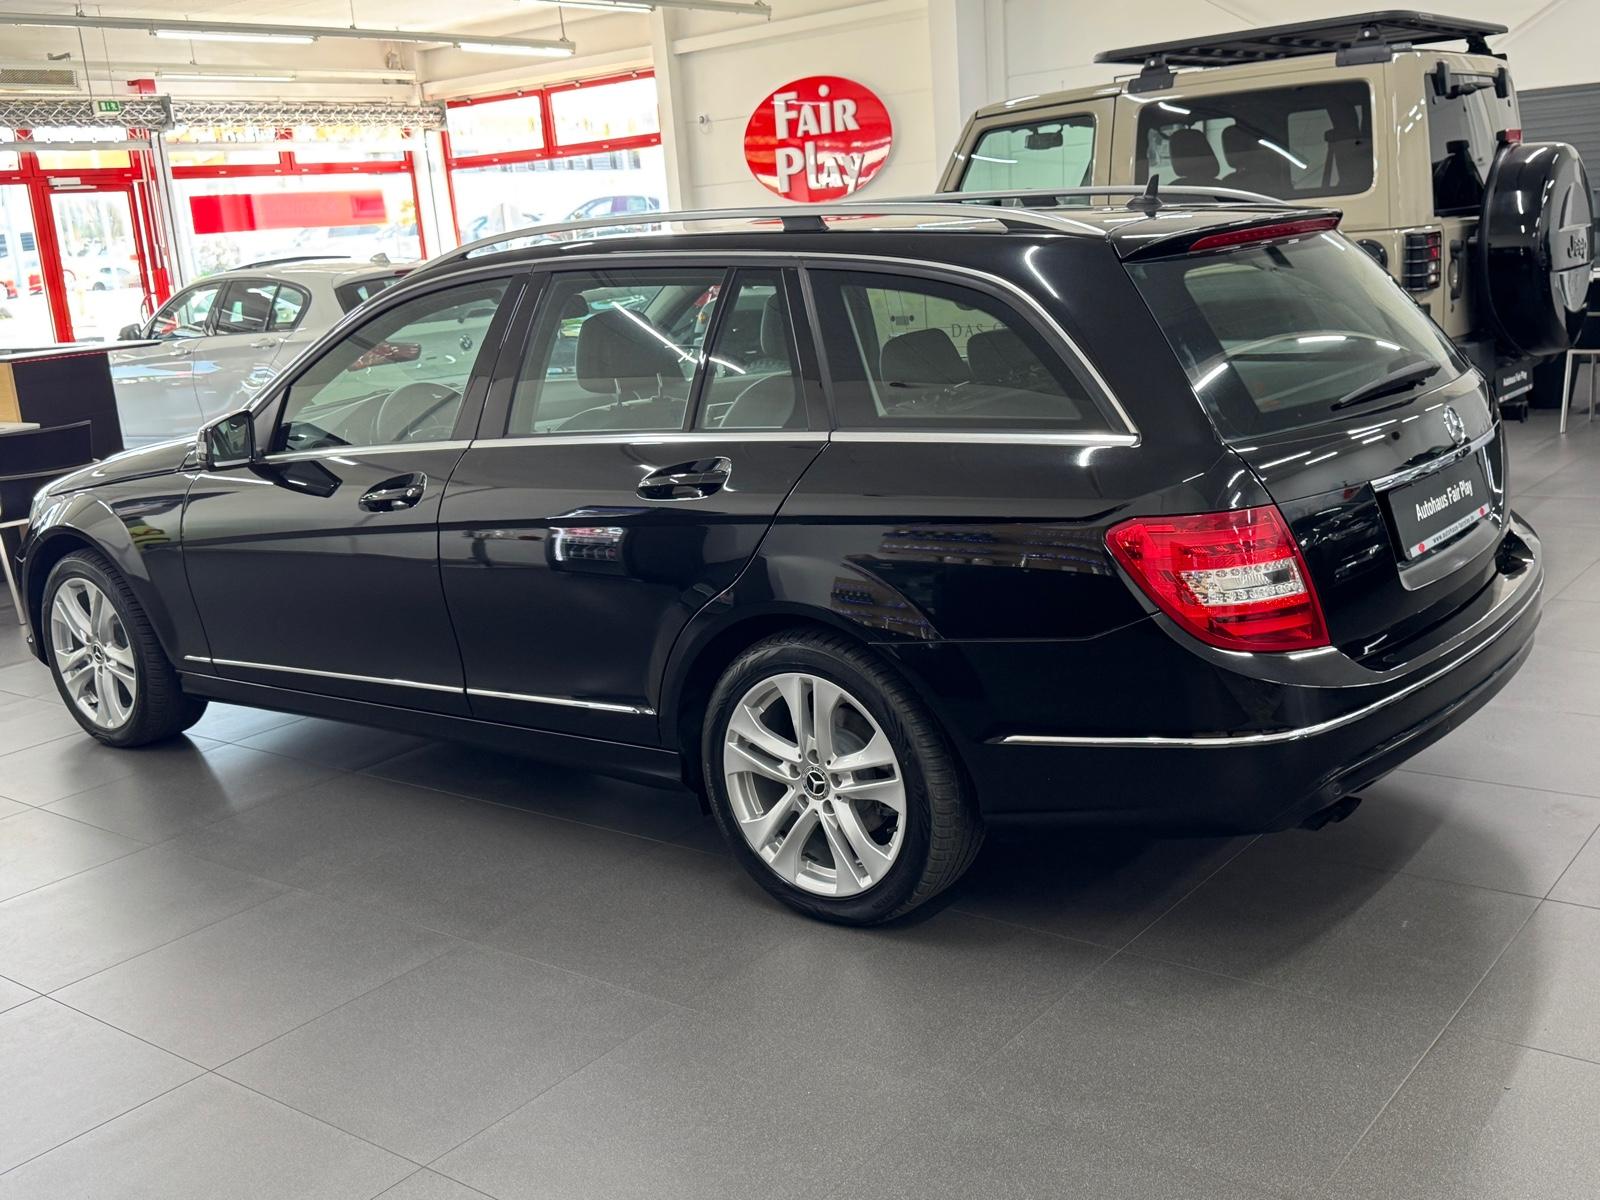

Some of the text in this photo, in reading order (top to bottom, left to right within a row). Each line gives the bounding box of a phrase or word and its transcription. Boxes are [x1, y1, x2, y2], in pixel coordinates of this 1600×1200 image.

[1567, 235, 1587, 259] Jeep
[1416, 480, 1473, 521] Autohaus Fair Play
